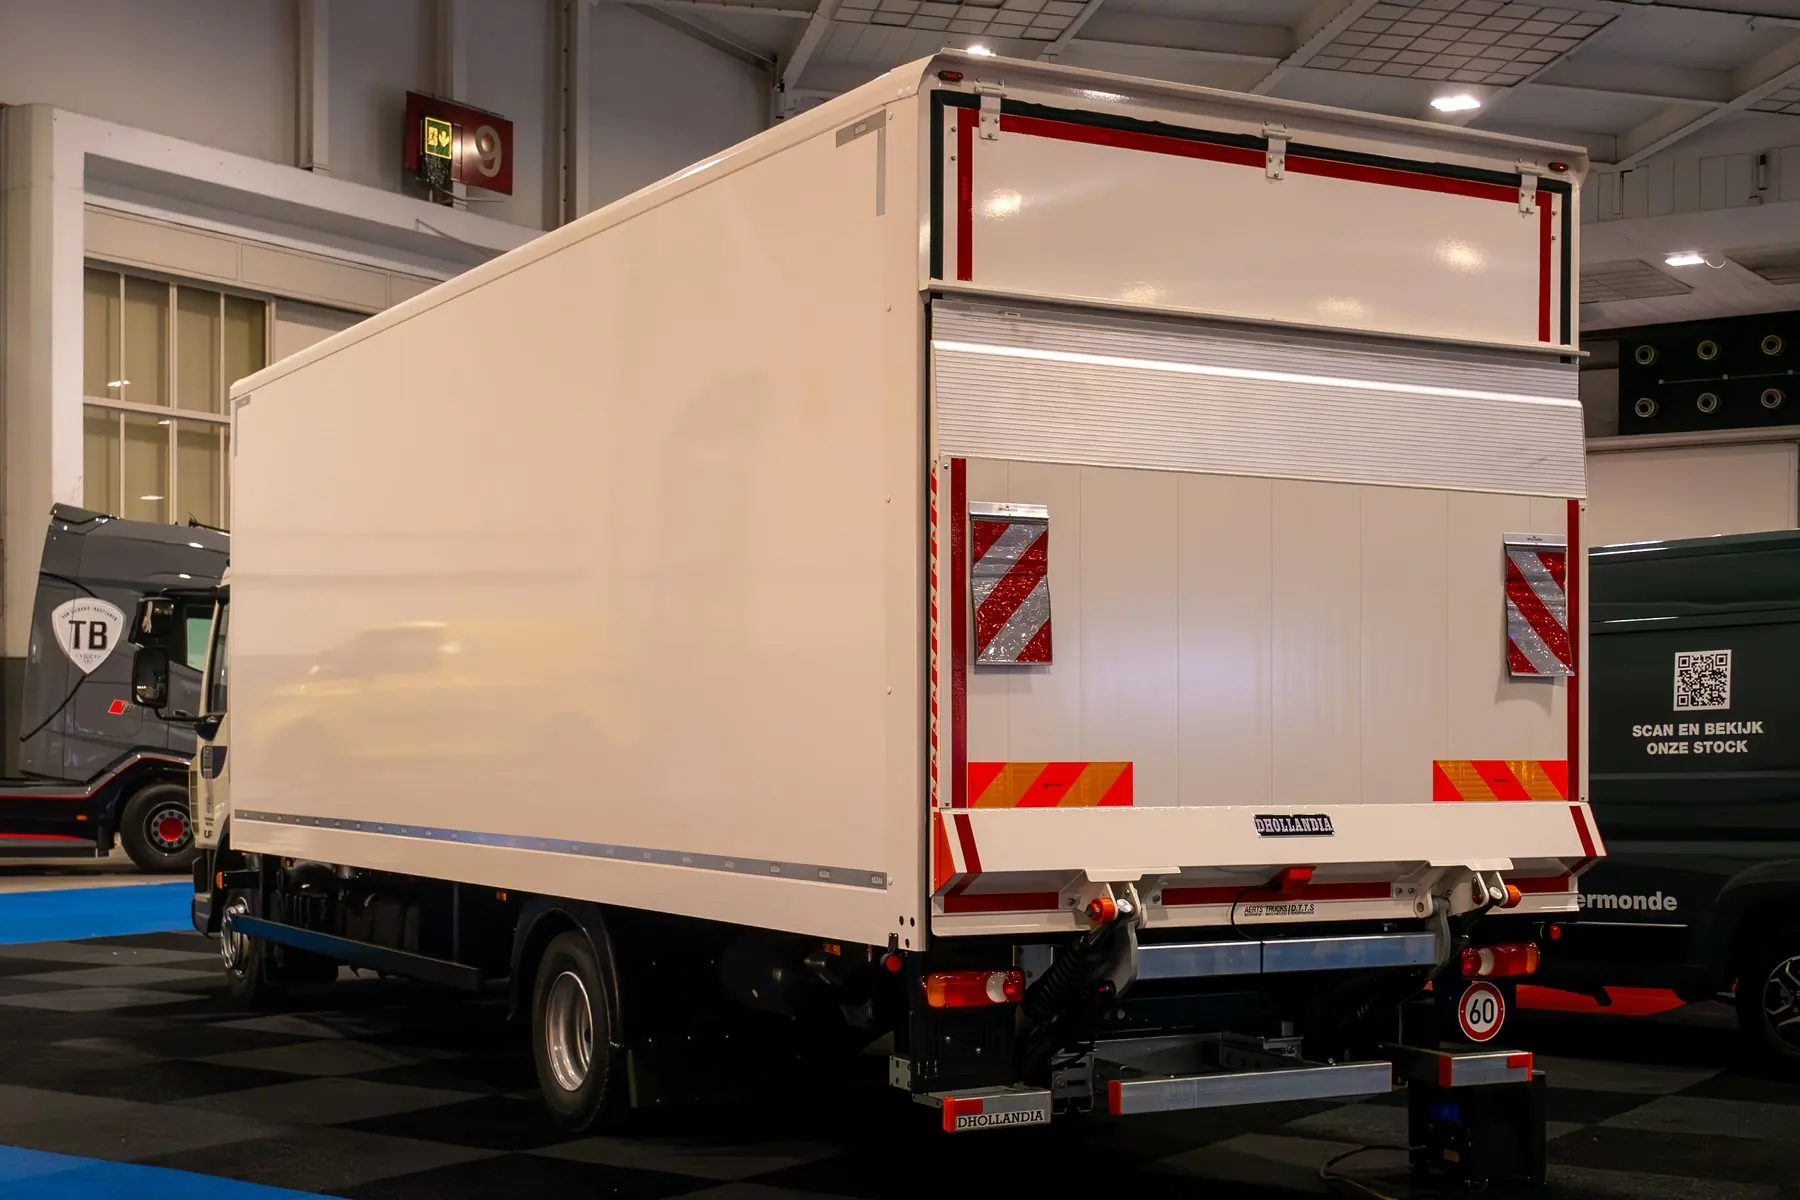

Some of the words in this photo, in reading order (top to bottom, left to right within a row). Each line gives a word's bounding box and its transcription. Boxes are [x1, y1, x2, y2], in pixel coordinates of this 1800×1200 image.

[475, 125, 502, 178] 9
[68, 620, 108, 650] TB
[1632, 724, 1674, 738] SCAN
[1678, 723, 1700, 736] EN
[1704, 721, 1764, 735] BEKIJK
[1646, 742, 1689, 755] ONZE
[1693, 740, 1749, 754] STOCK
[1255, 817, 1333, 833] DHOLLANDIA
[1244, 905, 1264, 914] AERTS
[1265, 904, 1287, 913] TRUCKS
[1469, 998, 1494, 1025] 60
[957, 1110, 1044, 1128] DHOLLANDIA
